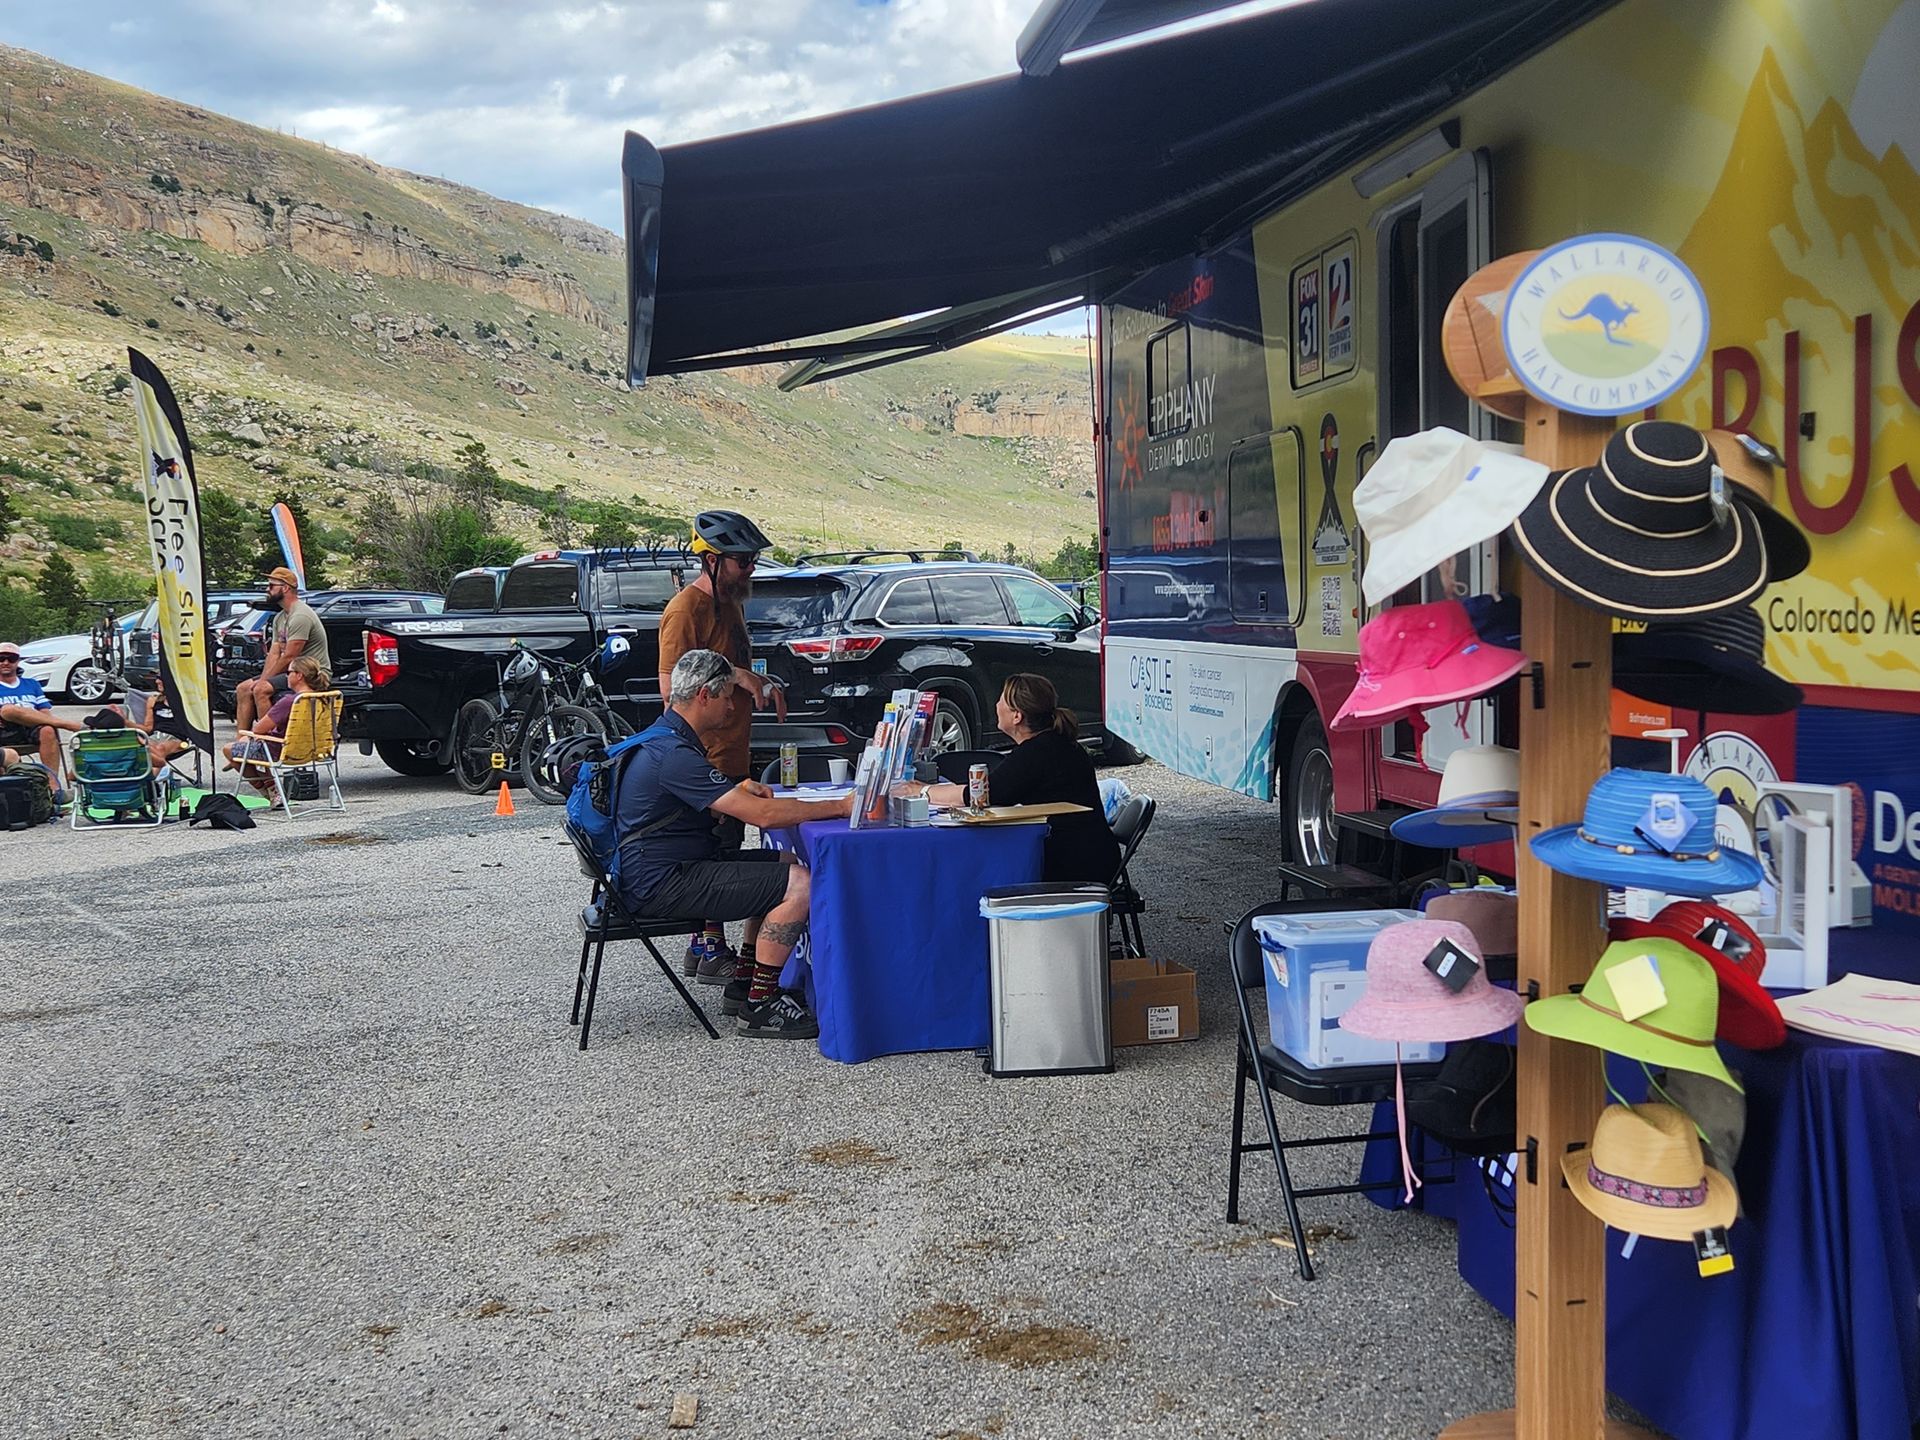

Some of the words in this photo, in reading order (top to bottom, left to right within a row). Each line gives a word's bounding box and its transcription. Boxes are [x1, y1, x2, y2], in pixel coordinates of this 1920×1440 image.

[1300, 272, 1318, 302] FOX
[1330, 257, 1351, 331] 2
[1528, 248, 1685, 301] WALLAROO
[1157, 299, 1167, 323] to
[1300, 302, 1318, 357] 31
[1522, 348, 1563, 391] HAT
[1572, 349, 1686, 404] COMPANY
[1149, 373, 1216, 439] EPIPHANY
[1149, 432, 1215, 472] DERMATOLOGY
[168, 498, 188, 573] Free
[178, 590, 194, 658] Skin
[1769, 597, 1875, 634] Colorado
[1130, 655, 1172, 695] CASTLE
[1144, 694, 1172, 712] BIOSCIENCES
